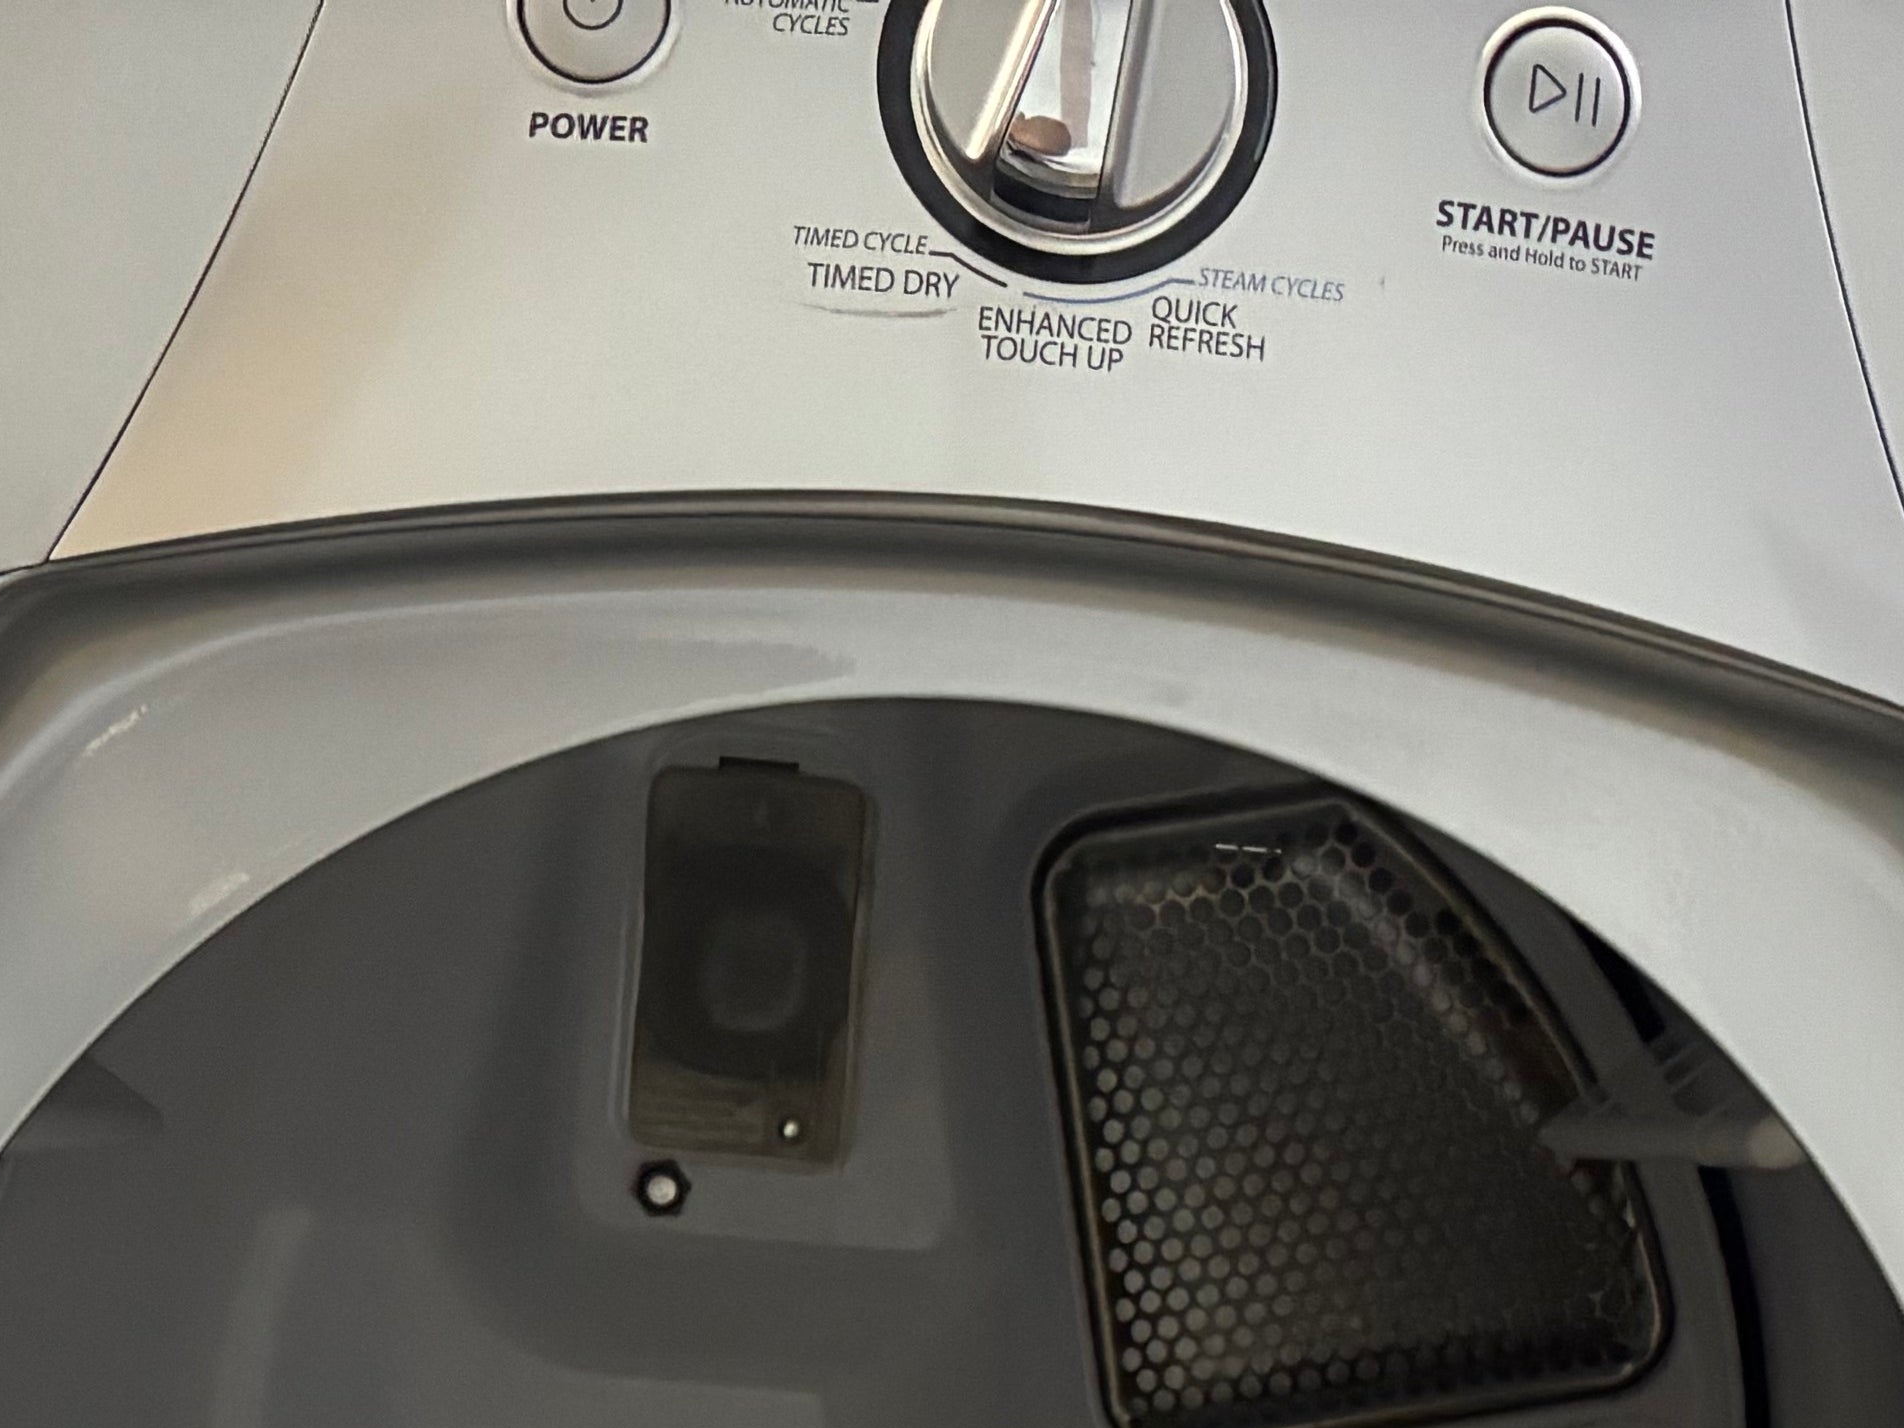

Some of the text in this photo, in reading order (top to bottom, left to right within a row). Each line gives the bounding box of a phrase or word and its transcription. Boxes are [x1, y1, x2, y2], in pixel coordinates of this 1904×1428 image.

[773, 13, 850, 36] CYCLES
[529, 112, 649, 143] POWER
[792, 226, 929, 256] TIMED CYCLE
[1436, 200, 1656, 260] START/PAUSE
[1442, 234, 1643, 281] Press and Hold to START
[808, 262, 960, 299] TIMED DRY
[1199, 267, 1346, 303] STEAM CYCLES
[977, 305, 1132, 344] ENHANCED
[1151, 296, 1237, 329] QUICK
[979, 333, 1124, 372] TOUCH UP
[1148, 323, 1266, 361] REFRESH
